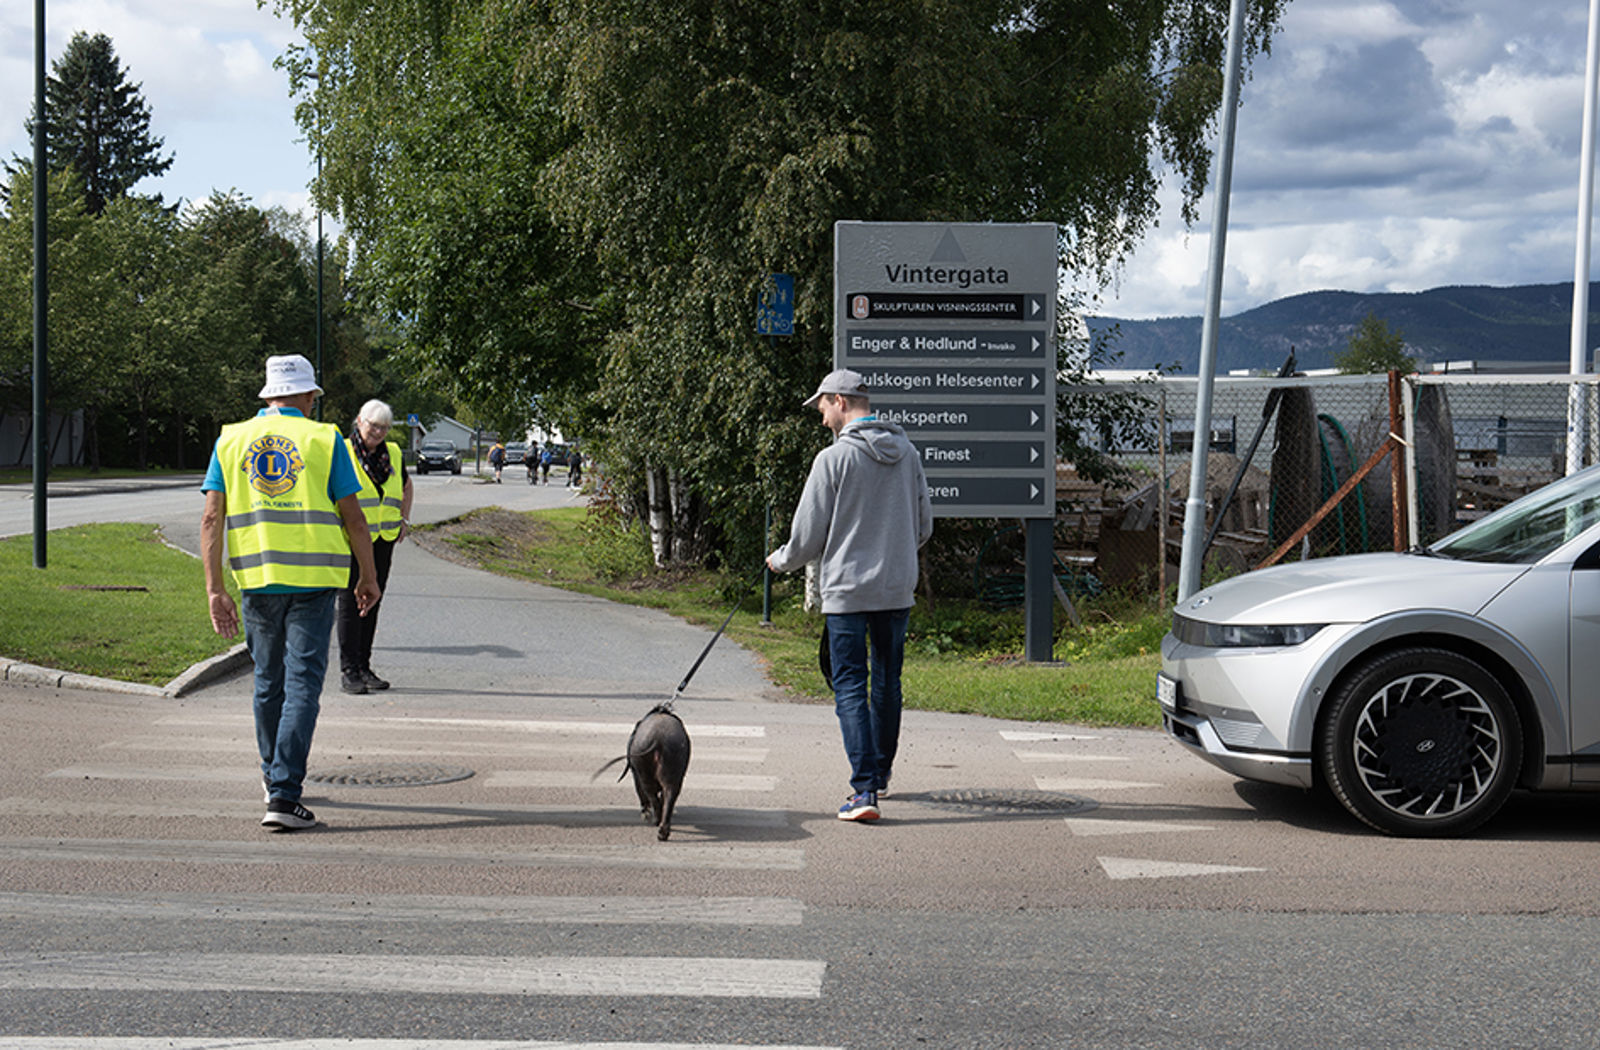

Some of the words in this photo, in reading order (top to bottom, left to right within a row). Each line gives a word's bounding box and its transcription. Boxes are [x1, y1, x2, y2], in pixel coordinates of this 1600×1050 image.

[885, 264, 1009, 288] Vintergata
[873, 302, 935, 312] SKULPTUREN
[936, 302, 1017, 312] VISNINGSSENTER
[851, 336, 897, 353] Enger
[899, 336, 911, 350] &
[914, 336, 977, 350] Hedlund
[864, 372, 931, 390] ulskogen
[936, 372, 1024, 387] Helsesenter
[871, 411, 968, 427] deleksperten
[255, 437, 291, 450] LIONS
[924, 447, 971, 461] Finest
[265, 455, 282, 475] L
